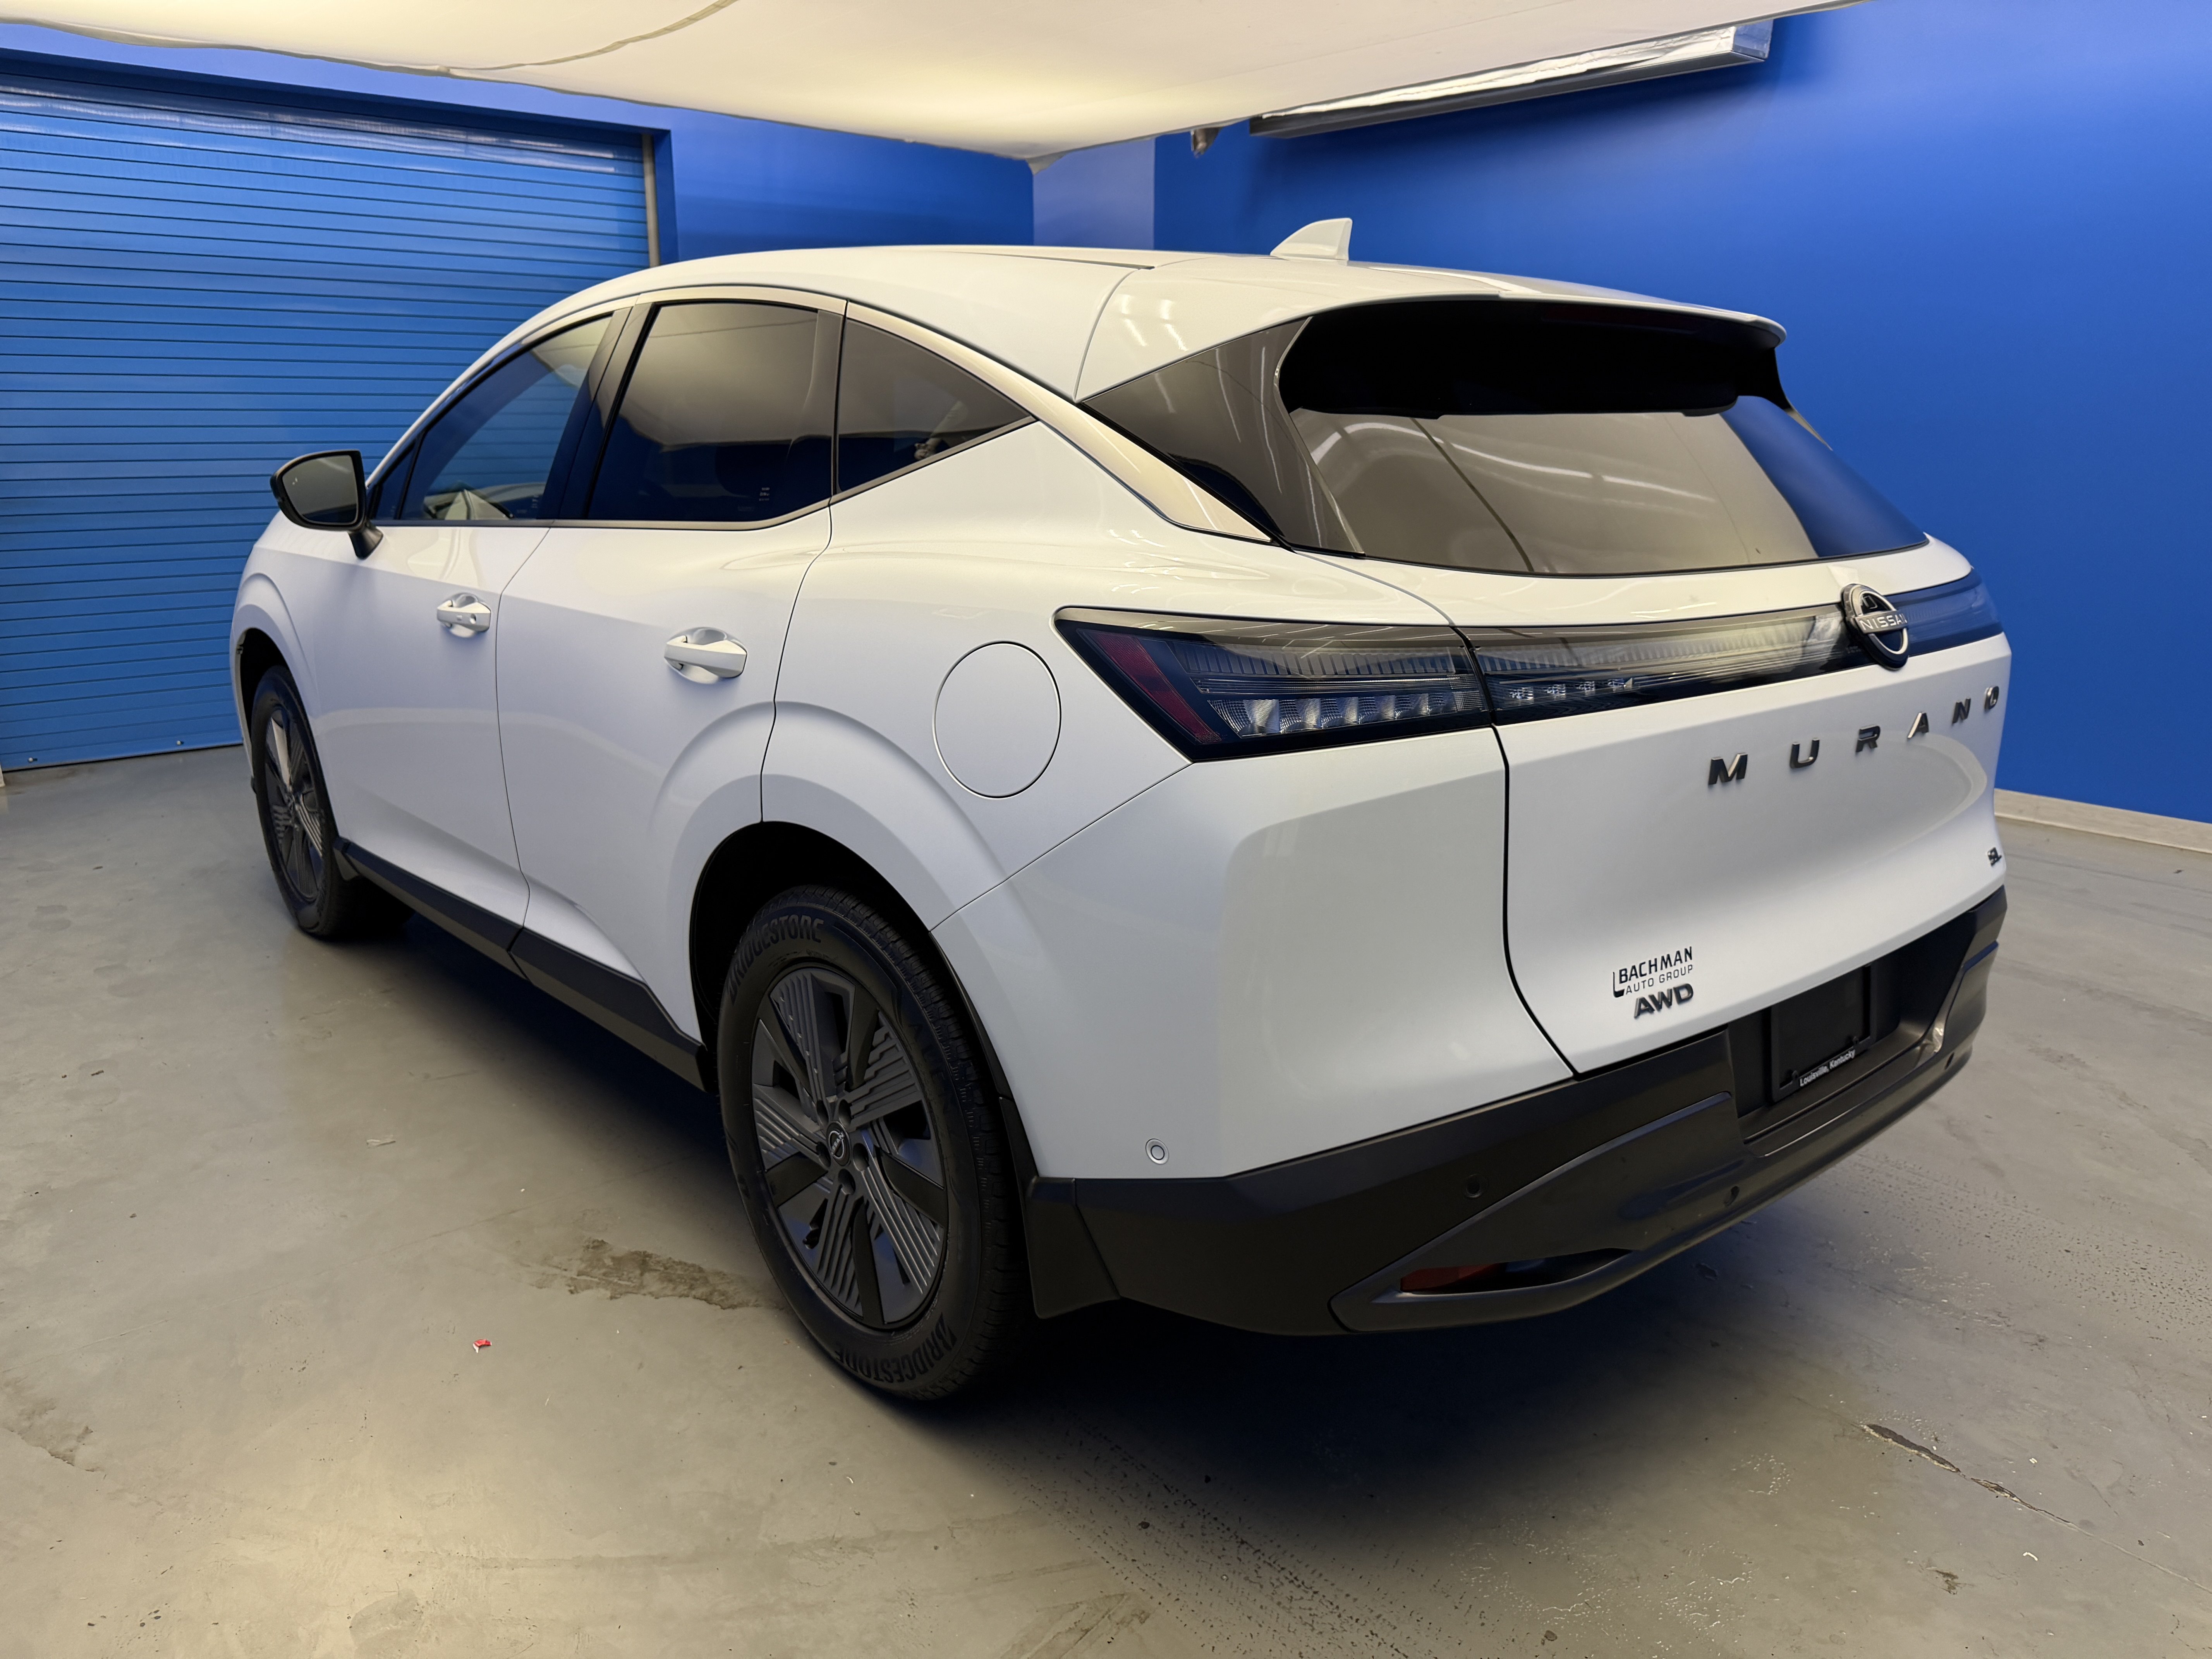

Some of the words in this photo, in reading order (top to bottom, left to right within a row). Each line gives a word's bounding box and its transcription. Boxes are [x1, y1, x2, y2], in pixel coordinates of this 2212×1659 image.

[1859, 613, 1908, 630] NISSAN
[1708, 685, 1999, 785] MURANO
[1619, 946, 1693, 984] BACHMAN
[1625, 978, 1654, 995] AUTO
[1659, 964, 1693, 983] GROUP
[1633, 983, 1694, 1019] AWD
[1829, 1049, 1856, 1070] Kentucky
